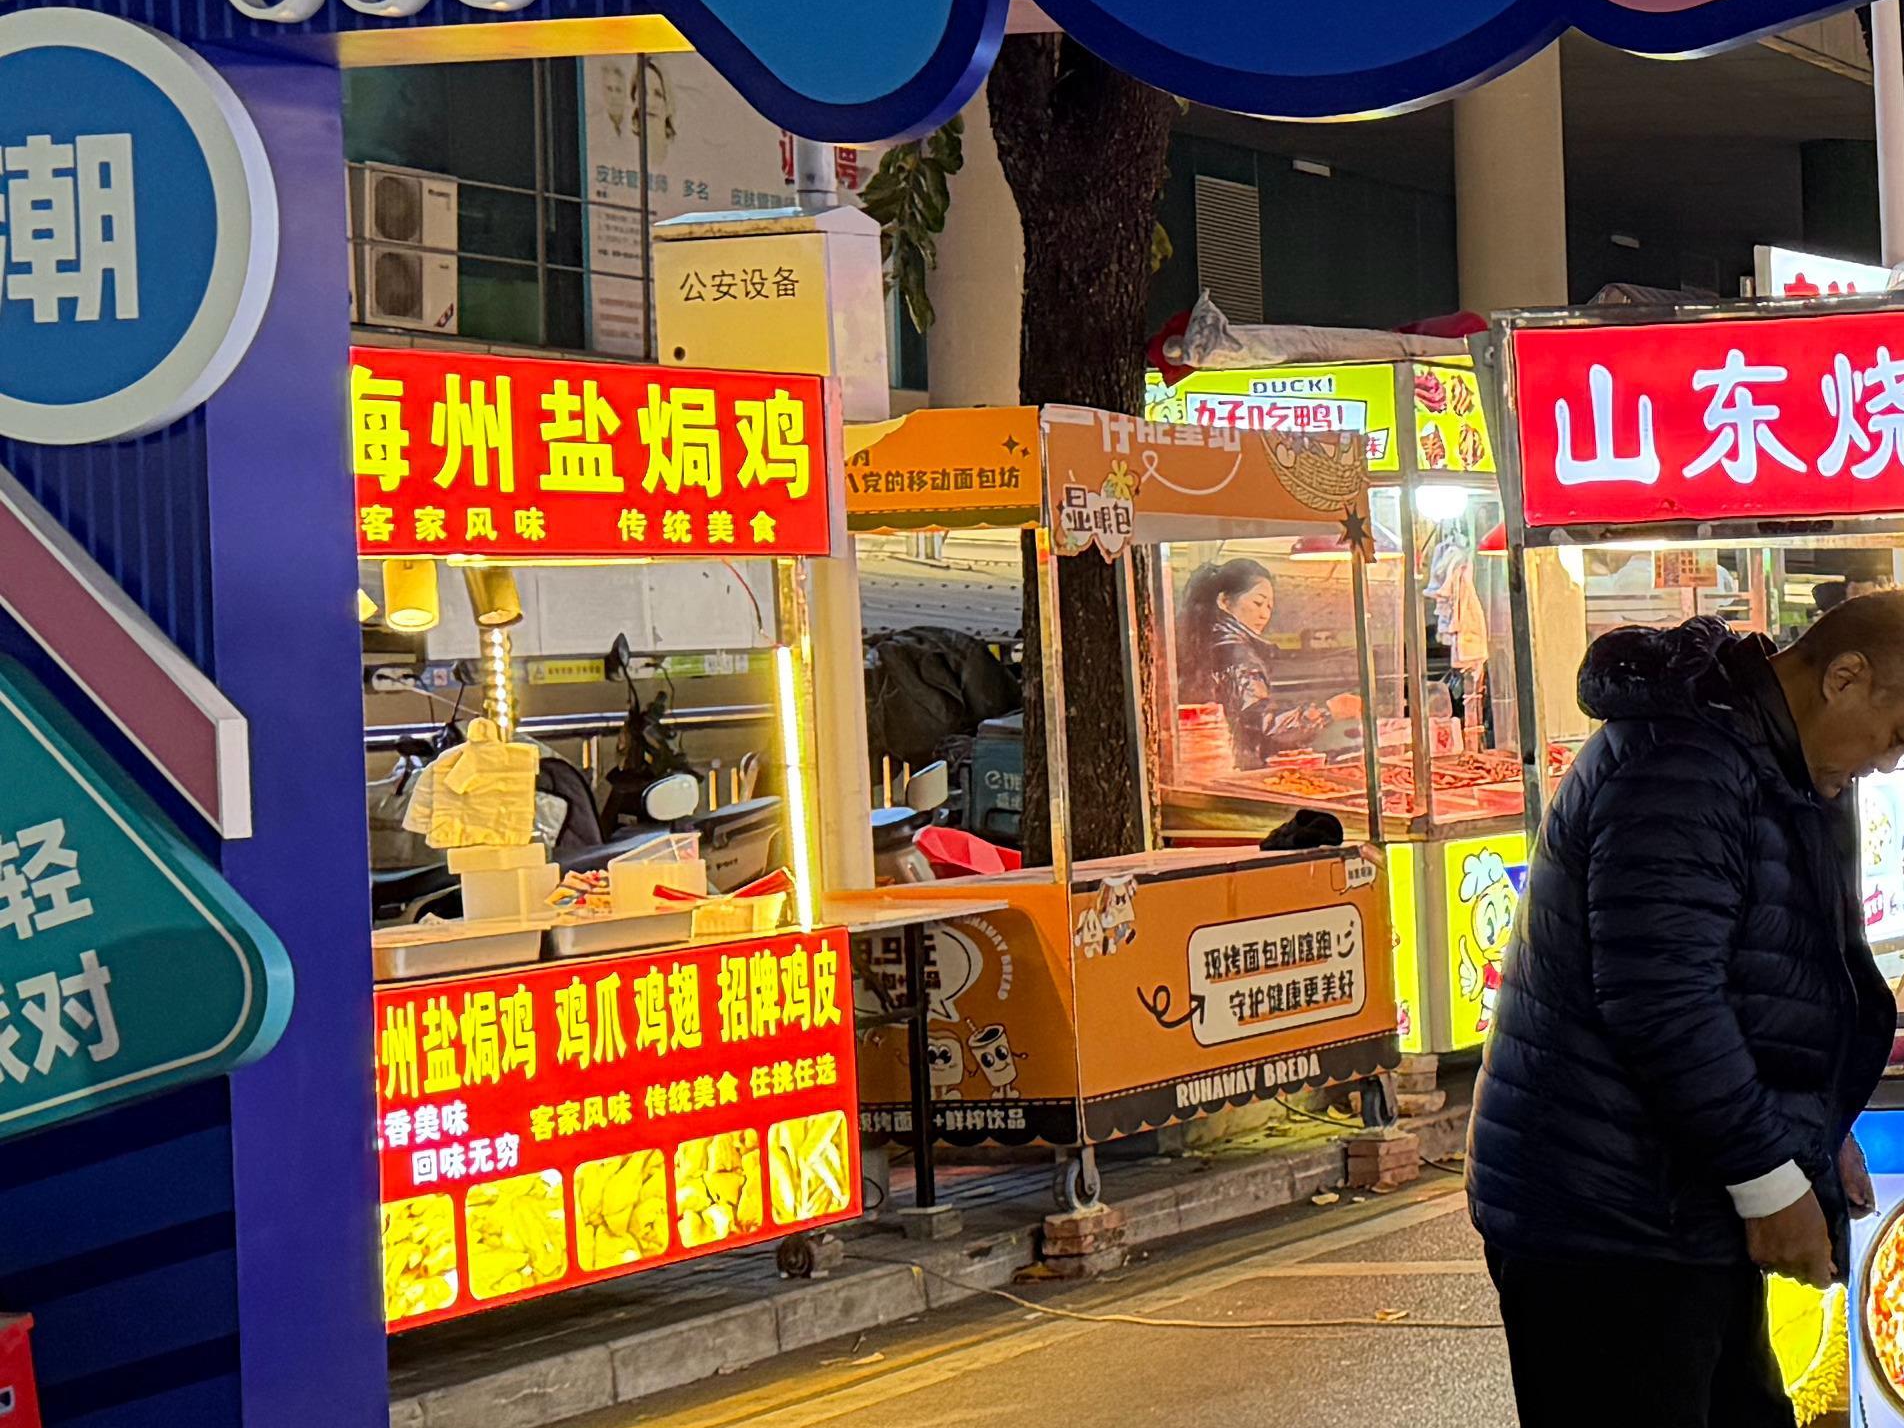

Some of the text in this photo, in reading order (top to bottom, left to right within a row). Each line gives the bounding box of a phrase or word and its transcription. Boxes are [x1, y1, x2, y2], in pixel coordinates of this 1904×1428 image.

[680, 266, 800, 302] 公安设备
[1252, 377, 1334, 393] DUCK!
[360, 506, 777, 545] 客家风味 传统美食
[375, 938, 842, 1100] 州盐焗鸡 鸡爪 鸡翅 招牌鸡皮
[1229, 969, 1354, 1022] 守护健康更美好
[376, 1053, 838, 1152] 香美味 客家风味 传统美食 任挑任选
[1176, 1053, 1321, 1109] RUNAWAY BREDA
[860, 1108, 1026, 1132] 现烤面+鲜榨饮品
[411, 1132, 520, 1186] 回味无穷
